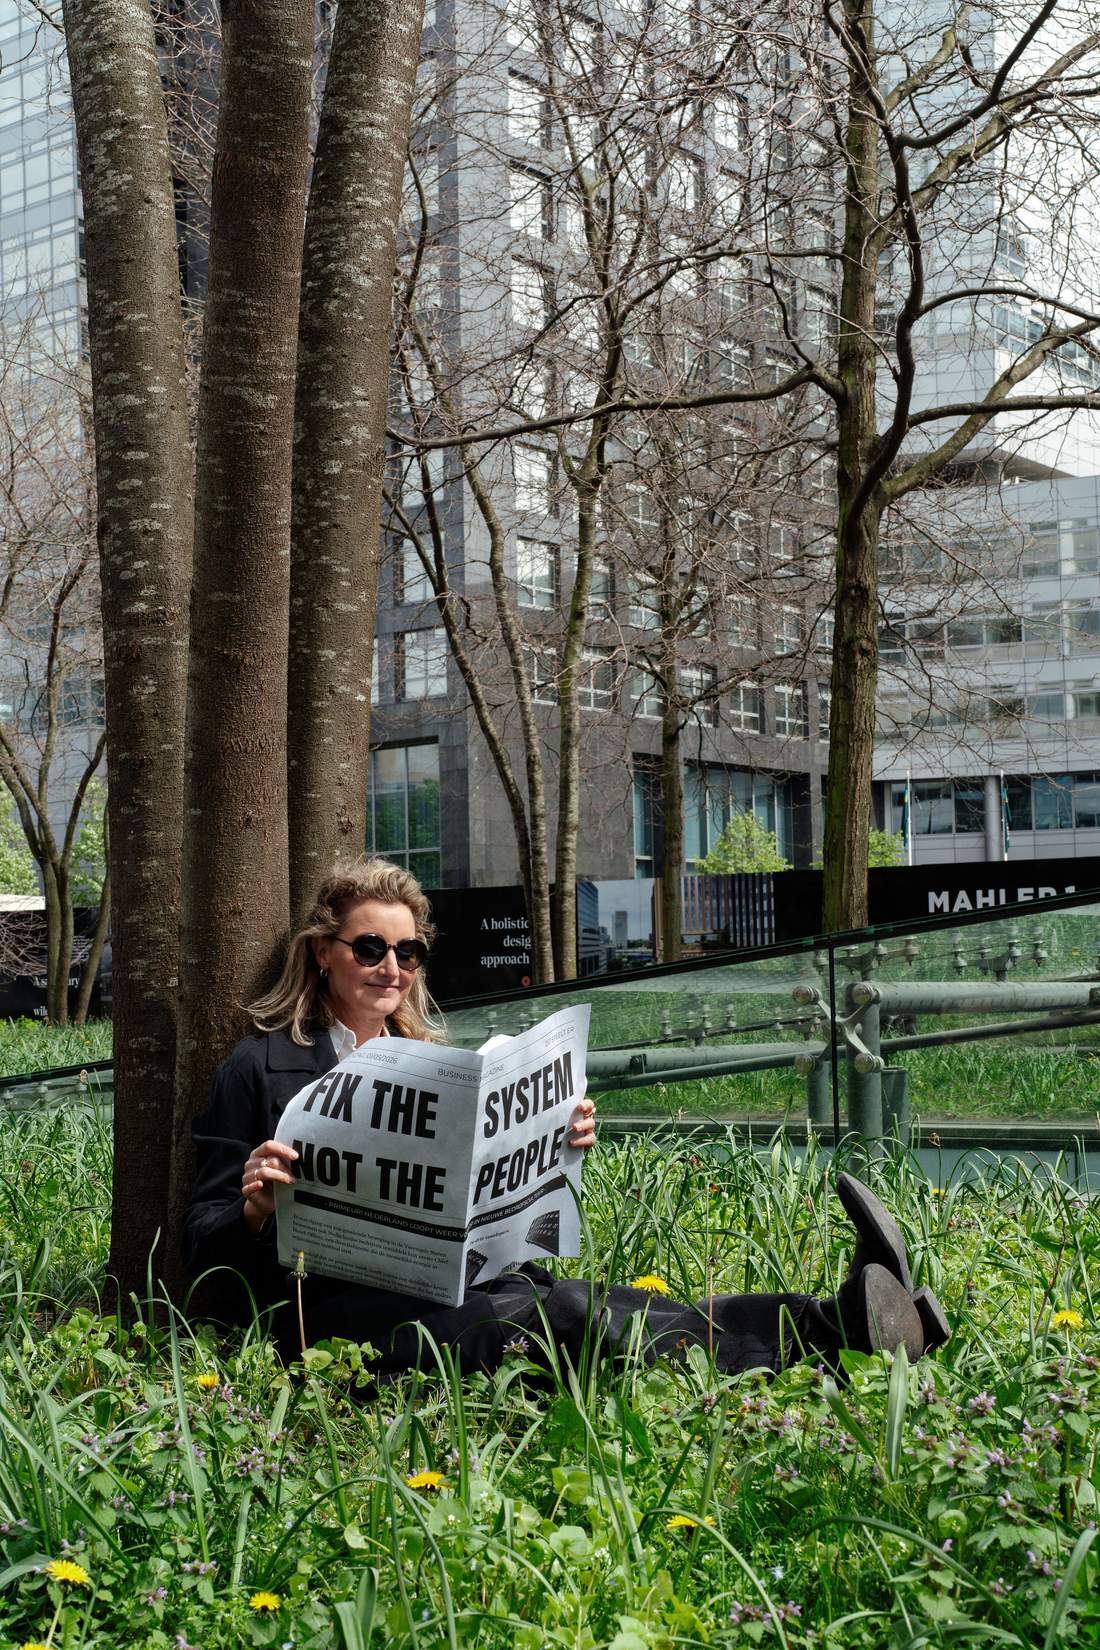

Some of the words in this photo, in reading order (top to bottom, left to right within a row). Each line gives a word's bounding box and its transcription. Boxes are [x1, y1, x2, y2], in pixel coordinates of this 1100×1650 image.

[480, 917, 489, 930] A
[490, 916, 529, 930] holistic
[503, 934, 531, 950] desig
[480, 952, 530, 968] approach
[437, 1067, 478, 1082] BUSINESS
[303, 1071, 363, 1123] FIX
[370, 1079, 439, 1139] THE
[483, 1051, 574, 1138] SYSTEM
[291, 1139, 363, 1193] NOT
[376, 1157, 447, 1212] THE
[472, 1125, 566, 1206] PEOPLE
[364, 1210, 408, 1229] NEDERLAND
[409, 1222, 434, 1234] LOOPT
[435, 1227, 458, 1238] WEER
[480, 1210, 503, 1223] NIEUWE
